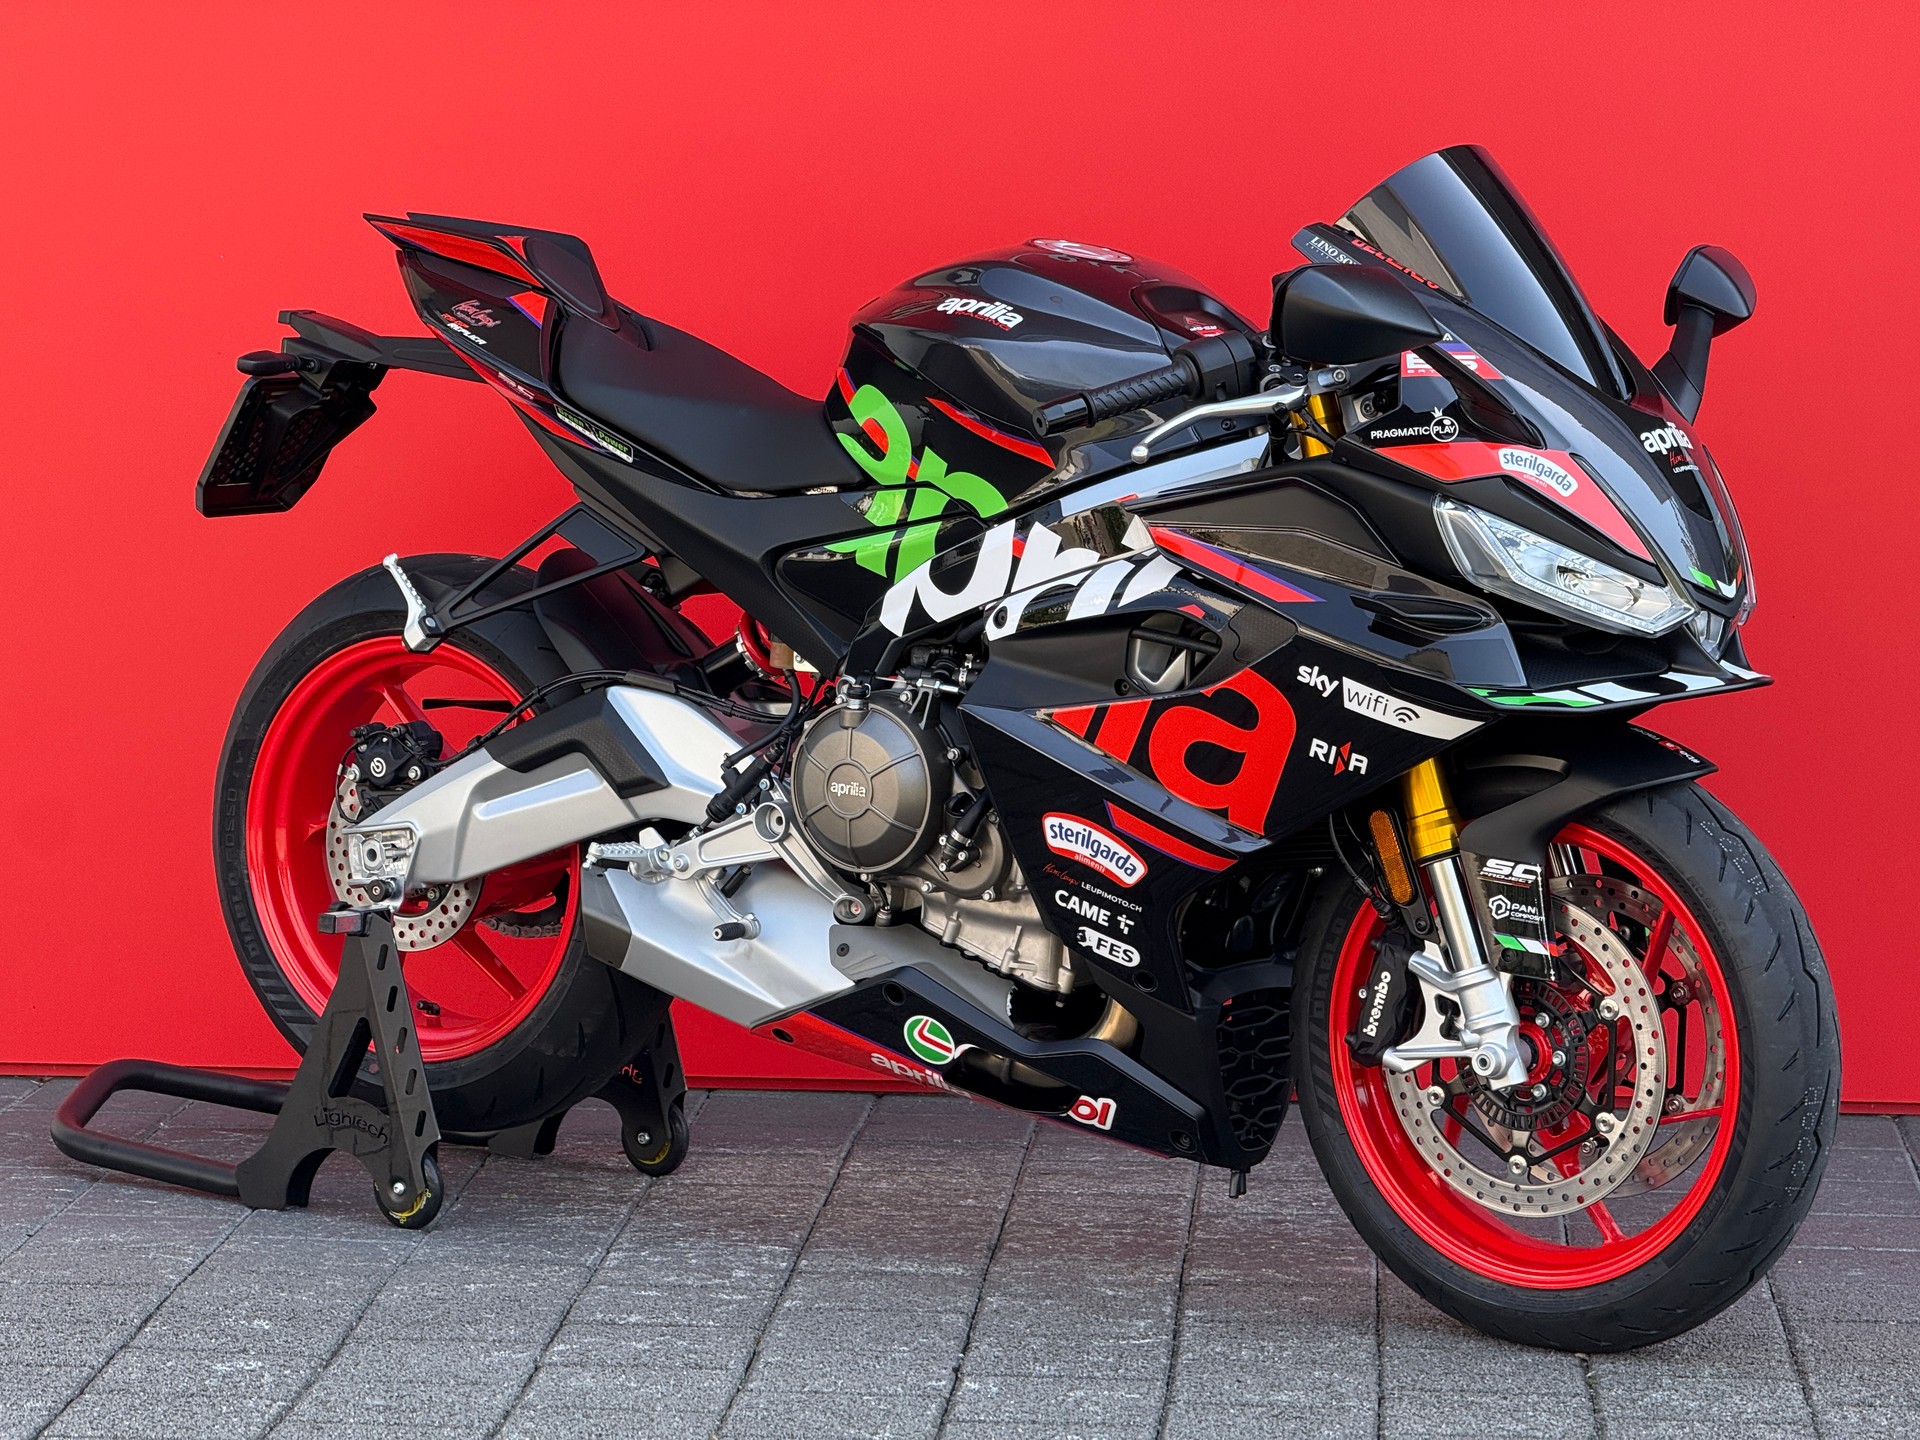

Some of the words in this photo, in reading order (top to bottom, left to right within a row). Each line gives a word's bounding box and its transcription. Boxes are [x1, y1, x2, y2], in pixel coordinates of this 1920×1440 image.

[1310, 236, 1339, 259] LINO
[936, 297, 1024, 329] aprilia
[954, 310, 1012, 332] RACING
[598, 430, 629, 453] Power
[1370, 426, 1430, 439] PRAGMATIC
[1433, 425, 1456, 434] PLAY
[1503, 452, 1572, 491] sterilgarda
[1297, 665, 1340, 698] sky
[1347, 688, 1390, 716] wifi
[830, 781, 867, 798] aprilia
[1049, 822, 1137, 877] sterilgarda
[1074, 853, 1106, 874] alimenti
[1482, 858, 1541, 880] SC
[1479, 871, 1534, 884] PROJECT
[1054, 889, 1111, 927] CAME
[1081, 881, 1143, 913] LEUPIMOTO.CH
[1510, 911, 1545, 922] COMPOSIT
[1095, 936, 1135, 964] FES
[1362, 971, 1392, 1038] brembo
[313, 1106, 389, 1145] Lightech
